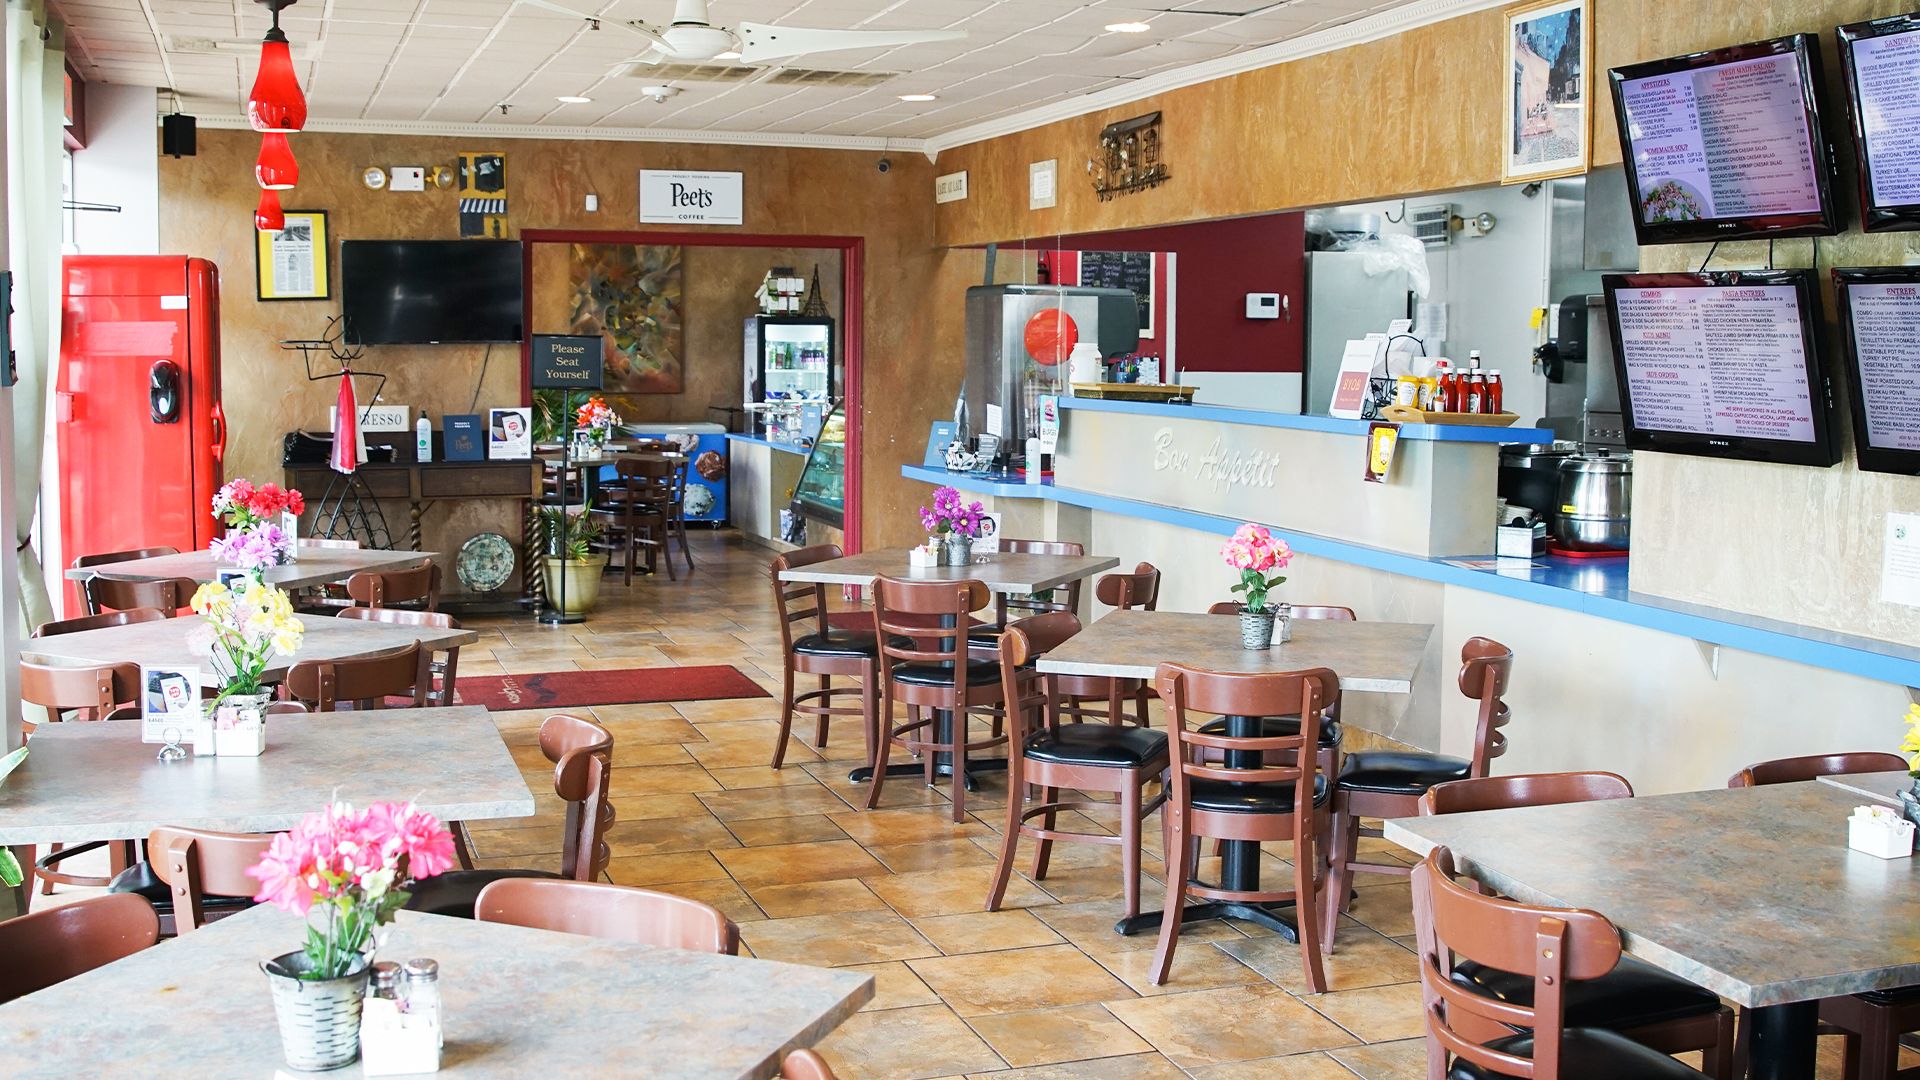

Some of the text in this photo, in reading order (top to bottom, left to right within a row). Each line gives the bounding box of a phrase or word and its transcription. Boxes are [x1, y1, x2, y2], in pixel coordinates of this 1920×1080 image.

[670, 182, 713, 208] Peet's
[551, 344, 585, 354] Please
[556, 357, 580, 366] Seat
[546, 369, 590, 380] Yourself
[1342, 378, 1361, 391] BYOB
[1154, 426, 1190, 473] Bon
